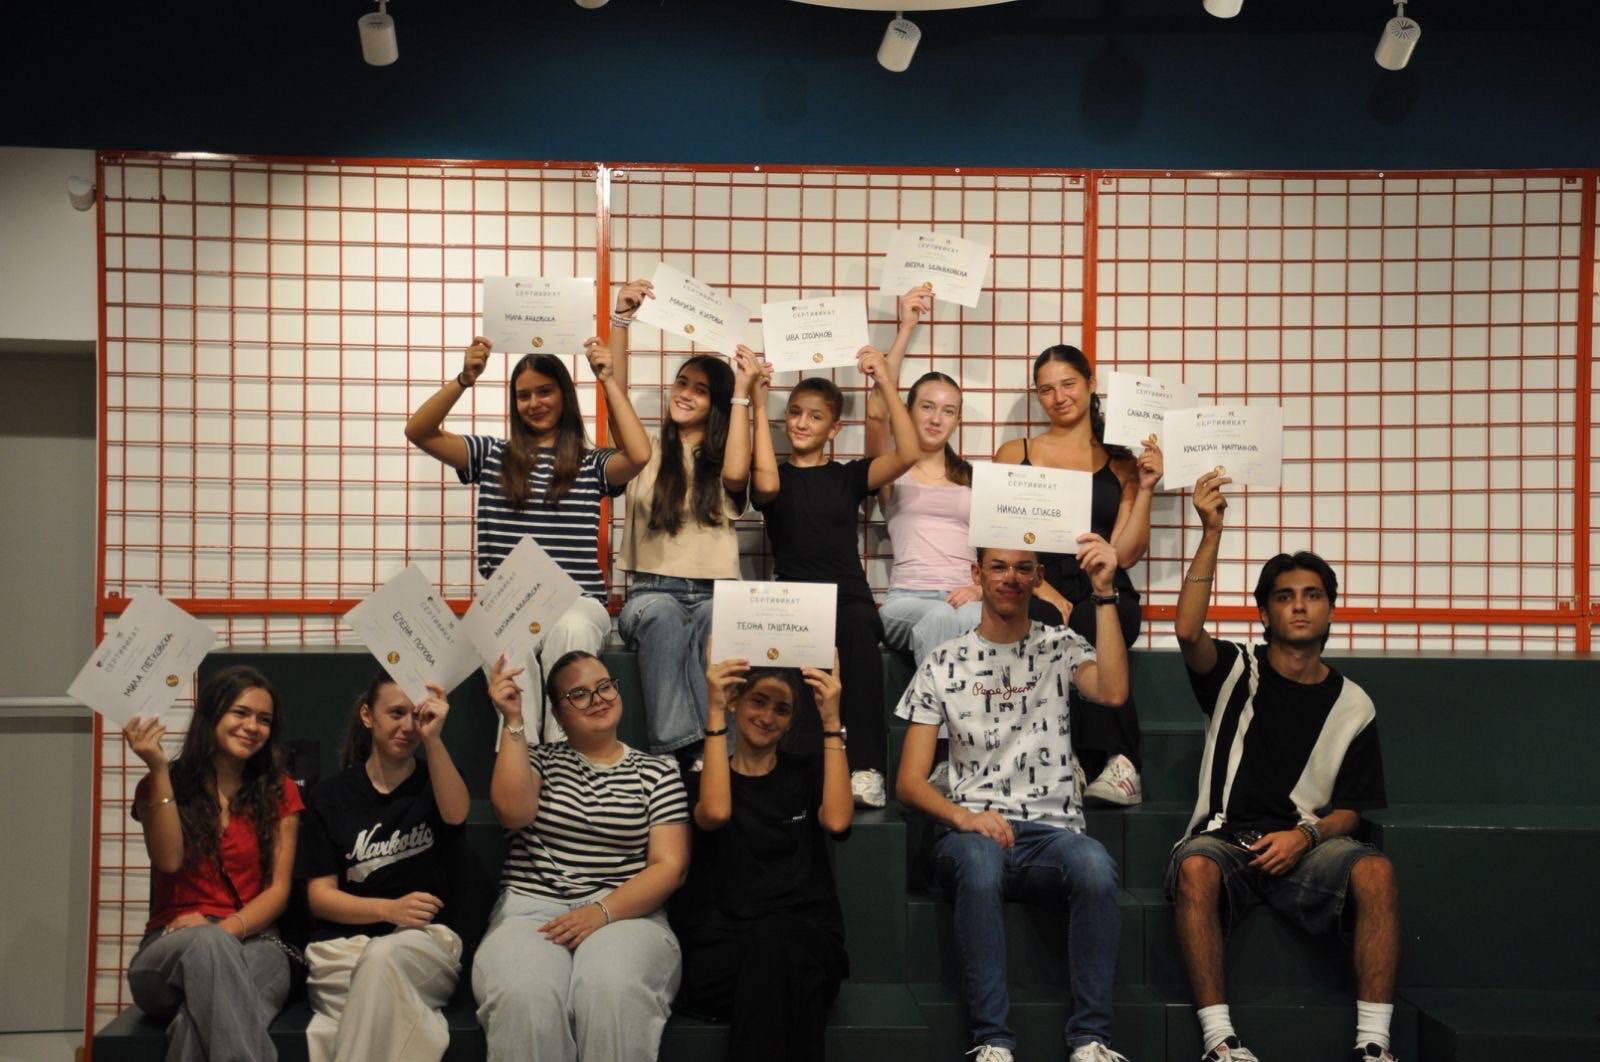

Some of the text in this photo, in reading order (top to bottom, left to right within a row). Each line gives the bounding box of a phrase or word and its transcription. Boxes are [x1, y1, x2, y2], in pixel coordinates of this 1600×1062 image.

[792, 309, 836, 319] СЕРТИФИКАТ
[1135, 388, 1174, 400] СЕРТИФИКАТ
[1196, 419, 1247, 428] СЕРТИФИКАТ
[1008, 480, 1057, 490] СЕРТИФИКАТ
[996, 504, 1027, 516] НИКОЛА
[1031, 507, 1062, 518] СПАСЕВ
[749, 597, 801, 605] СЕРТИФИКАТ
[736, 621, 809, 633] ТЕОНА ГАШТАРСКА
[392, 610, 414, 637] ЕЛЕНА
[414, 637, 436, 667] ПОПОВА
[123, 674, 144, 697] МИЛА
[141, 632, 174, 673] ПЕТКОВСКА
[972, 681, 1003, 697] Pepe
[345, 822, 434, 861] Narkotic
